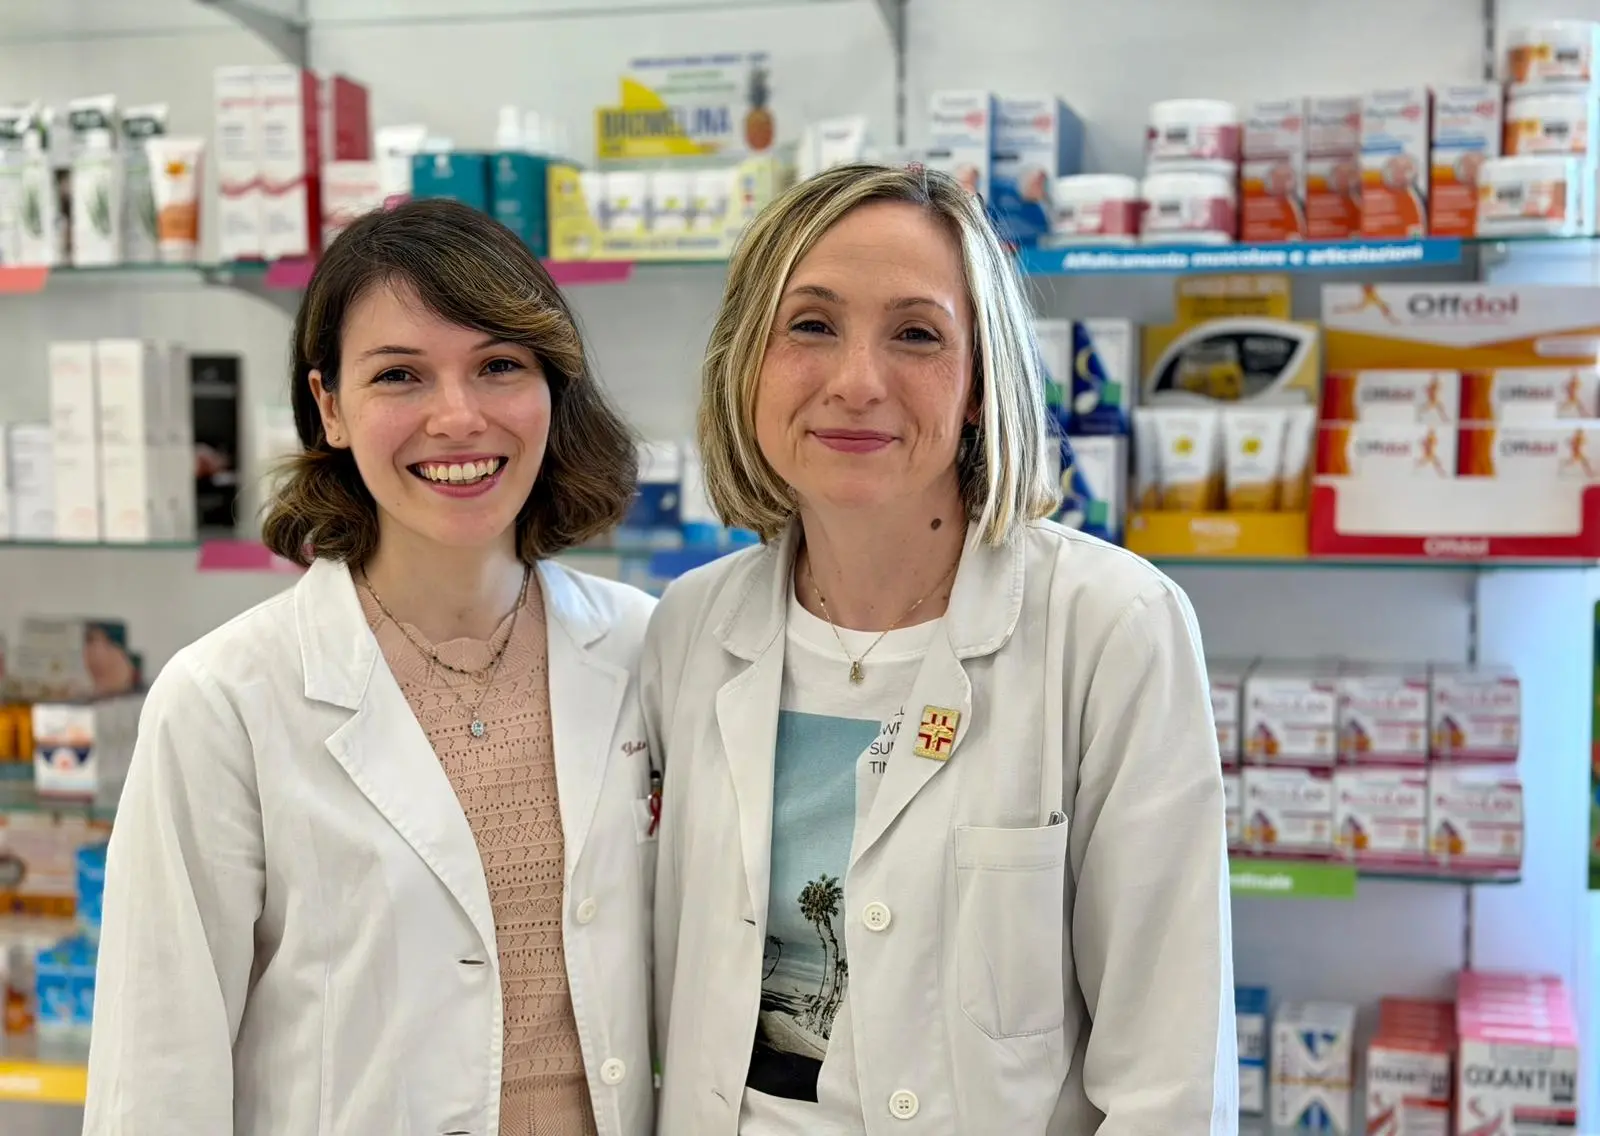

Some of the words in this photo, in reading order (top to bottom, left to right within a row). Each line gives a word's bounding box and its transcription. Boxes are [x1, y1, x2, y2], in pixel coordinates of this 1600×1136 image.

[1307, 244, 1423, 265] articolazioni
[1407, 293, 1519, 318] Offdol
[1464, 1064, 1576, 1091] OXANTIN
